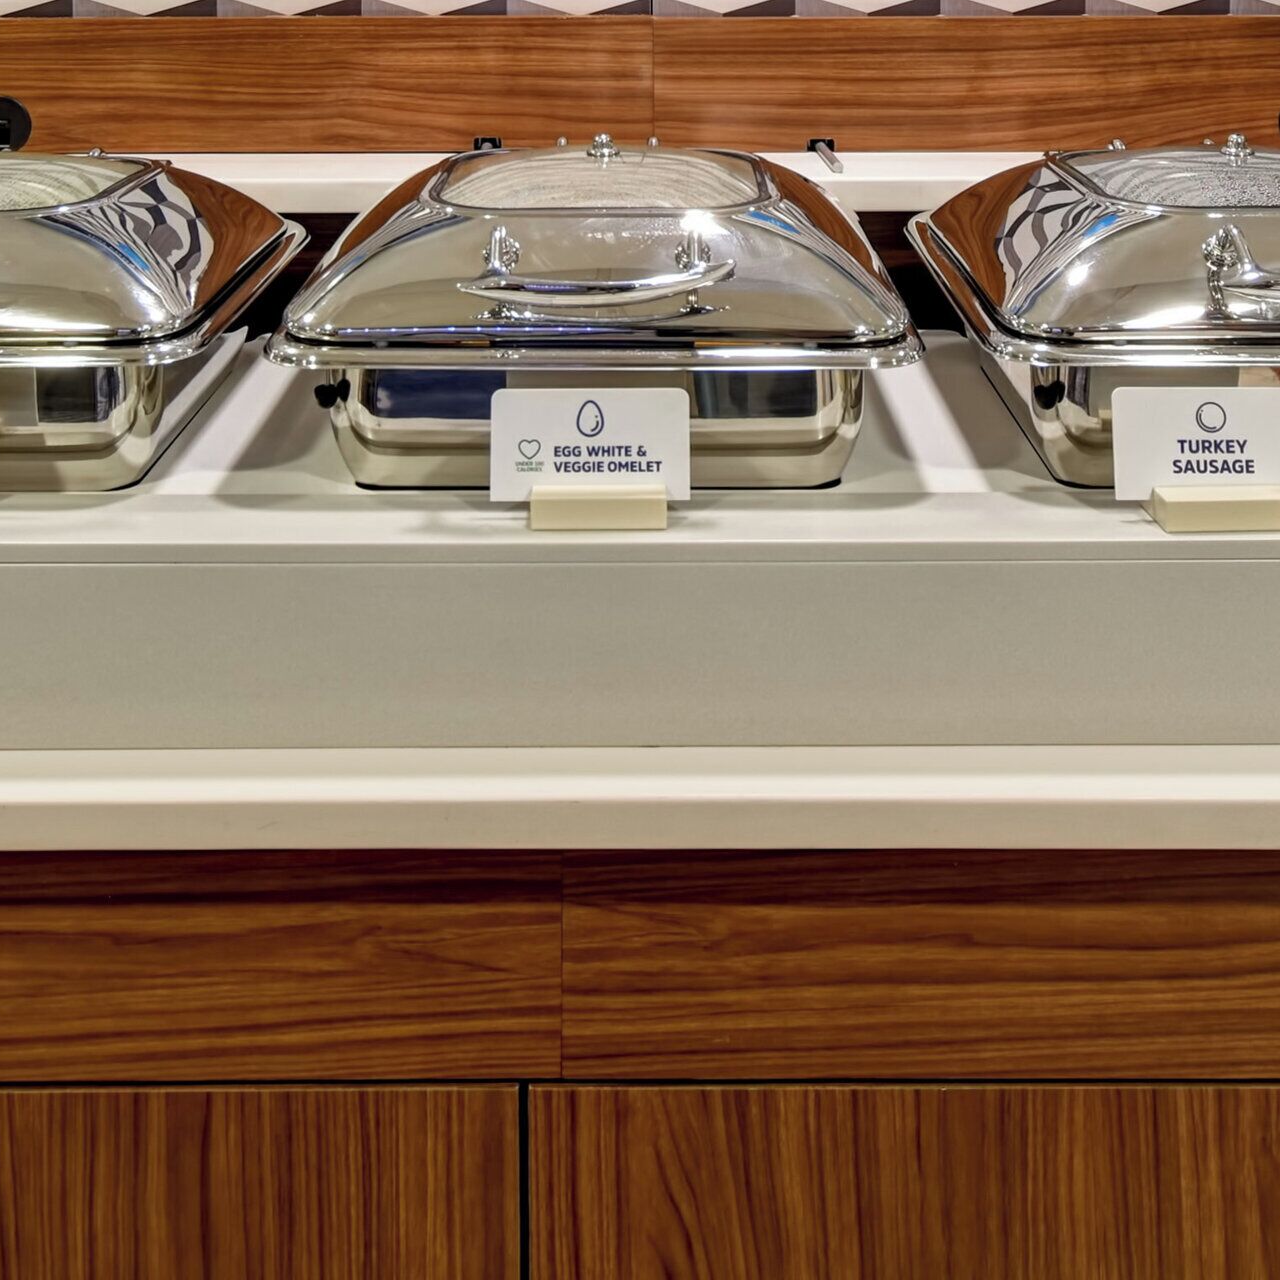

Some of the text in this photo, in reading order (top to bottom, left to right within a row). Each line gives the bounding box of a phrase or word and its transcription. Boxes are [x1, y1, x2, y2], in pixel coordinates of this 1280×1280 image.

[554, 445, 647, 457] EGG WHITE &
[1177, 439, 1248, 455] TURKEY
[553, 461, 663, 473] VEGGIE OMELET
[1172, 458, 1256, 475] SAUSAGE
